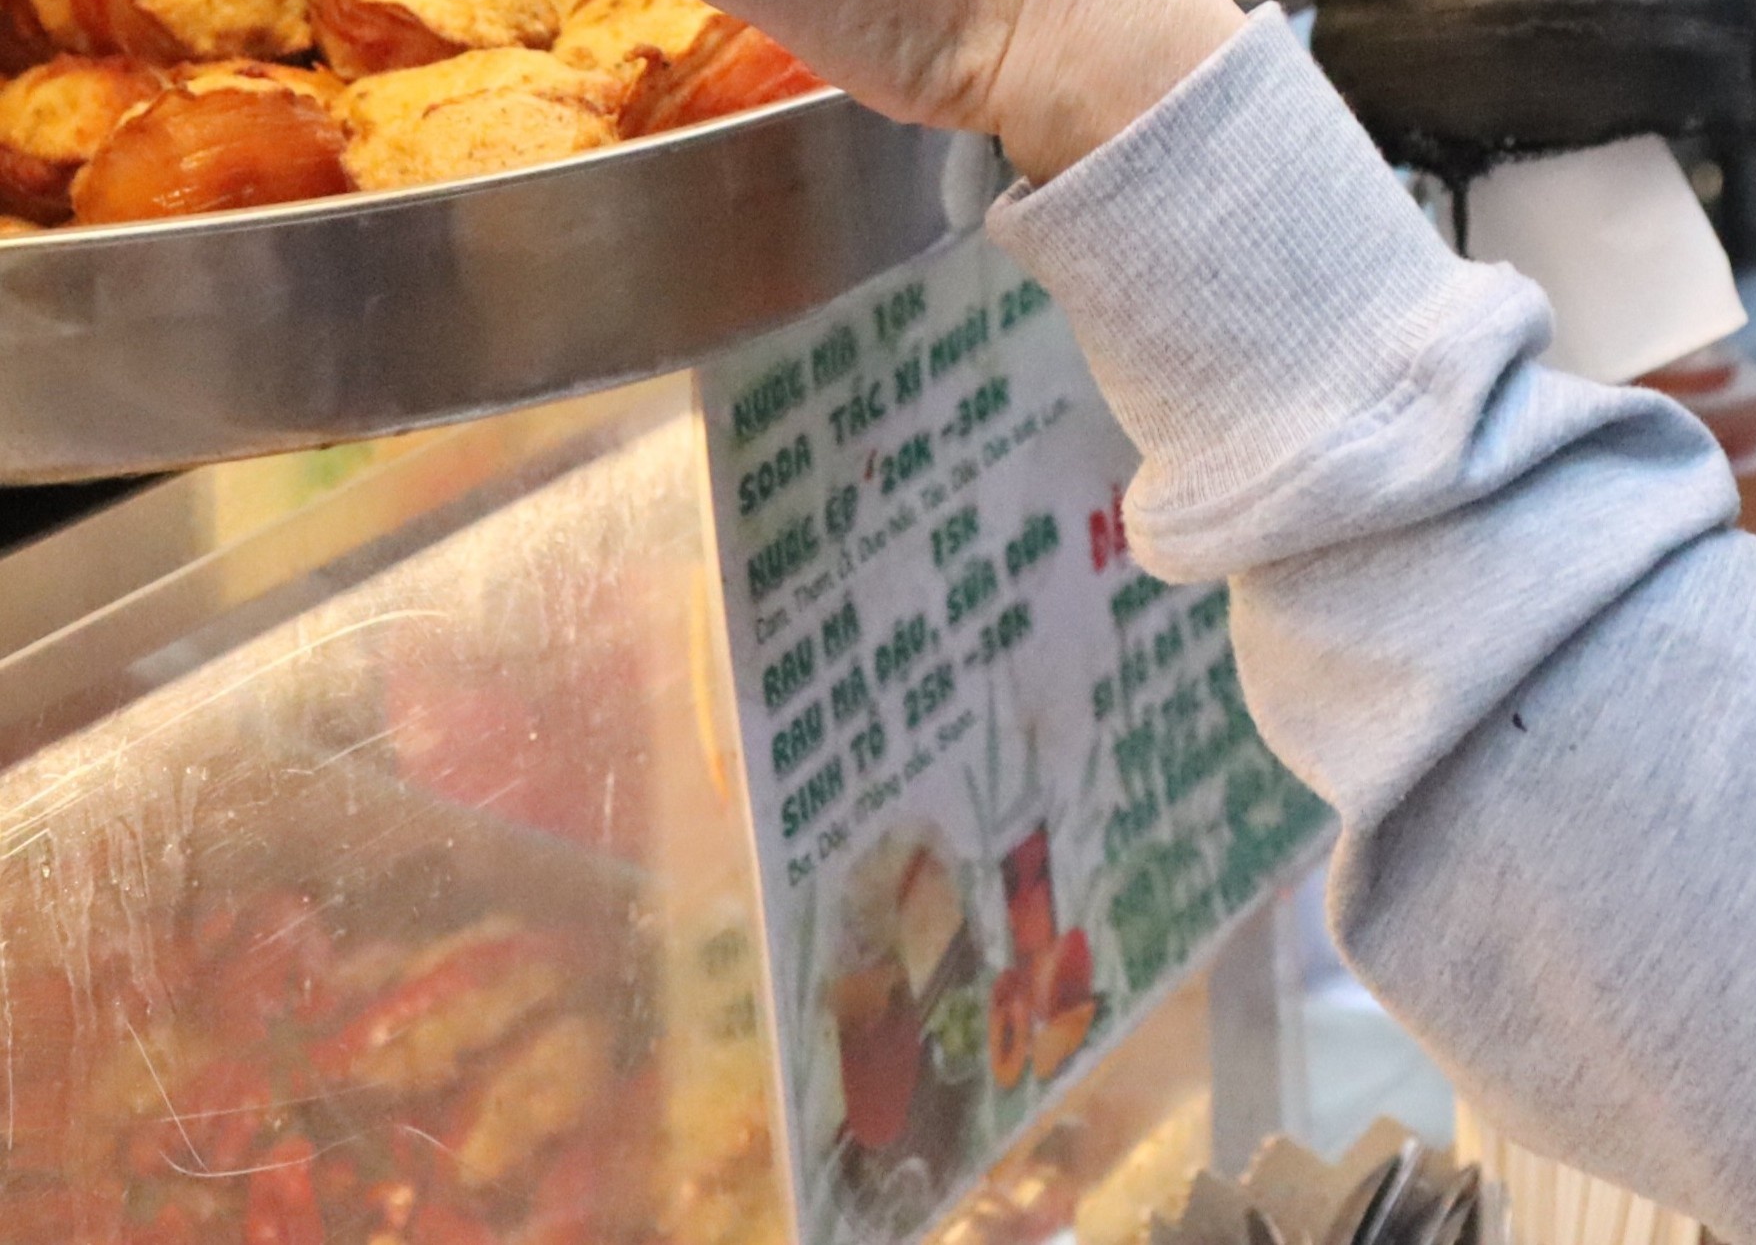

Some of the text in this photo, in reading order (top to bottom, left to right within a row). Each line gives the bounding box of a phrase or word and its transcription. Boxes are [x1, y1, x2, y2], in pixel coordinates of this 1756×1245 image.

[739, 435, 811, 516] SODA
[880, 433, 932, 495] 20K
[763, 633, 814, 711] RAU
[772, 702, 823, 777] RAU
[781, 757, 843, 839] SINH
